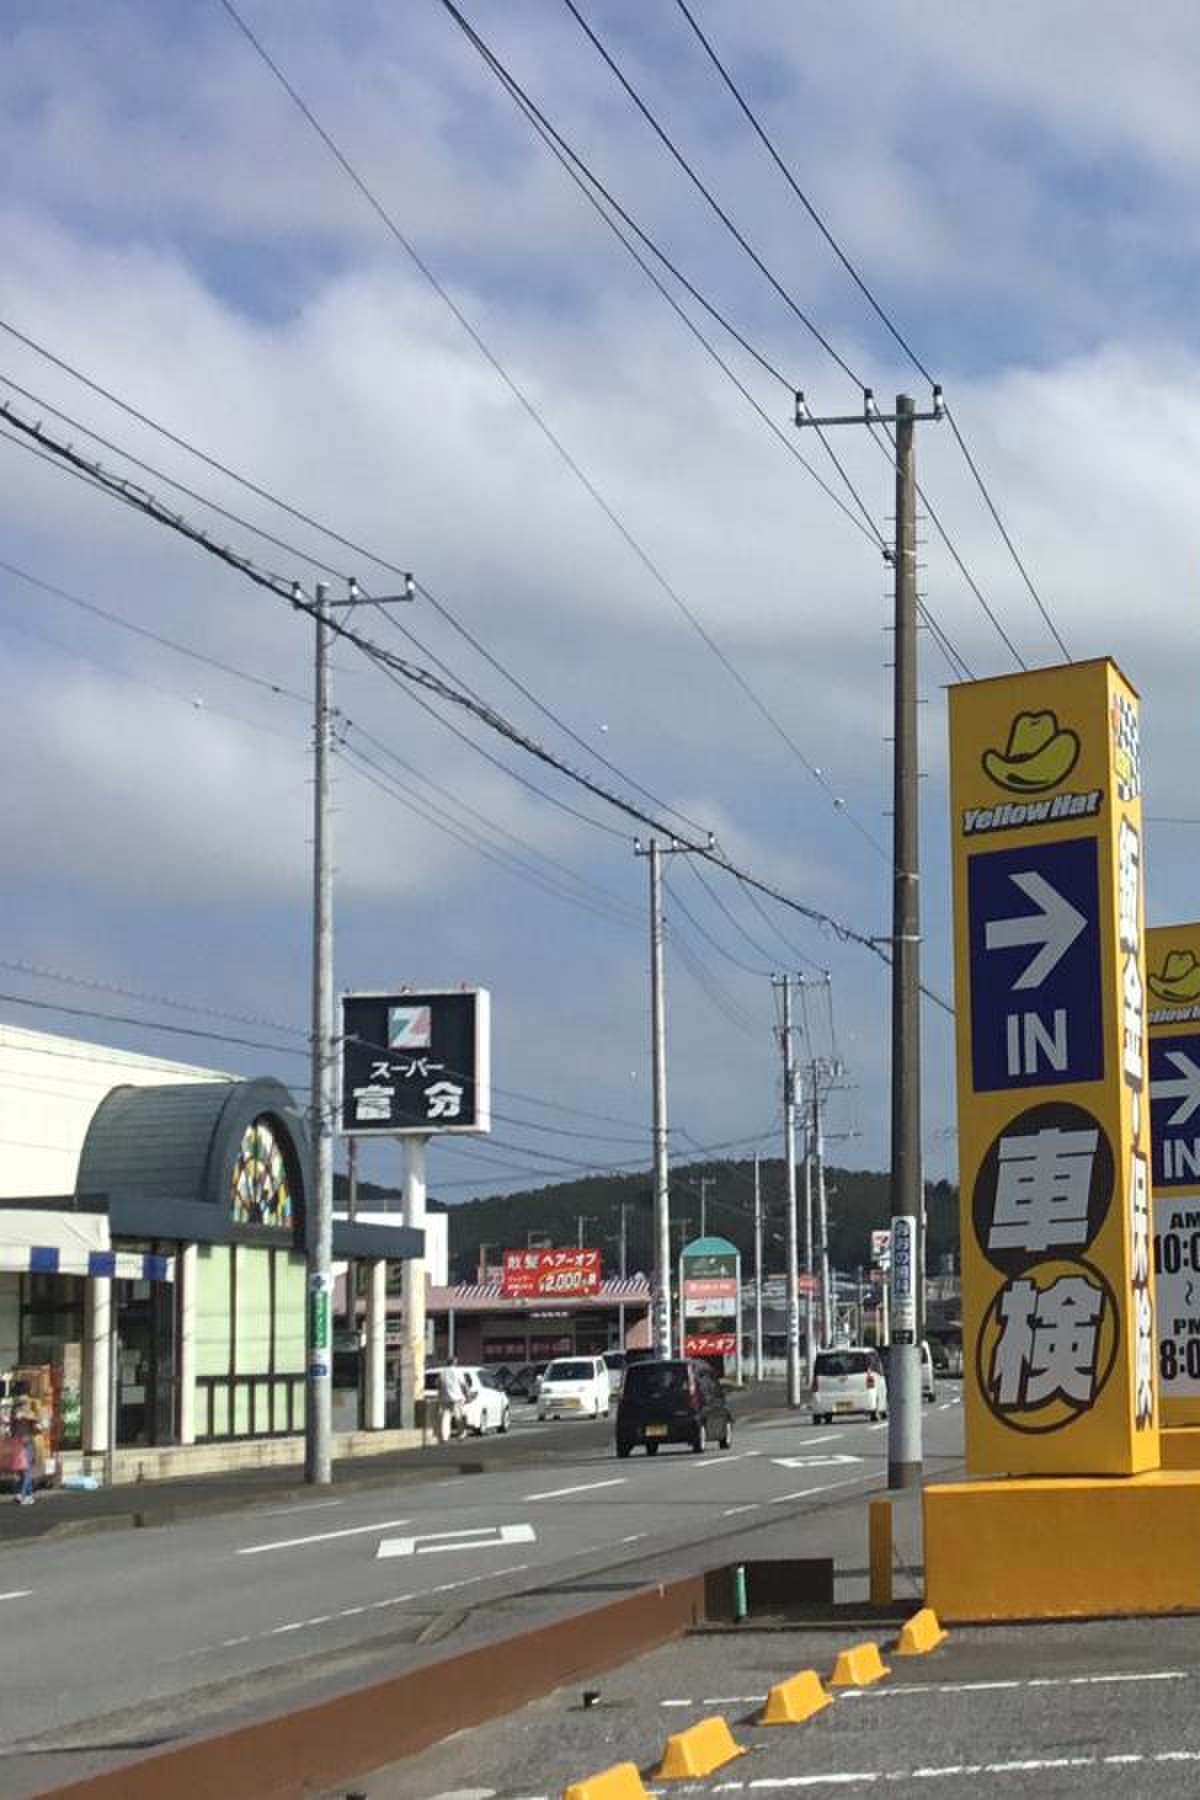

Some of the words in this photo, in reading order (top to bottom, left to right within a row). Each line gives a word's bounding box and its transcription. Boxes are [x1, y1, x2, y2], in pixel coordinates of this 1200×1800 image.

[369, 1057, 445, 1080] スーパー
[1007, 1008, 1069, 1076] IN
[987, 1127, 1106, 1410] 車検
